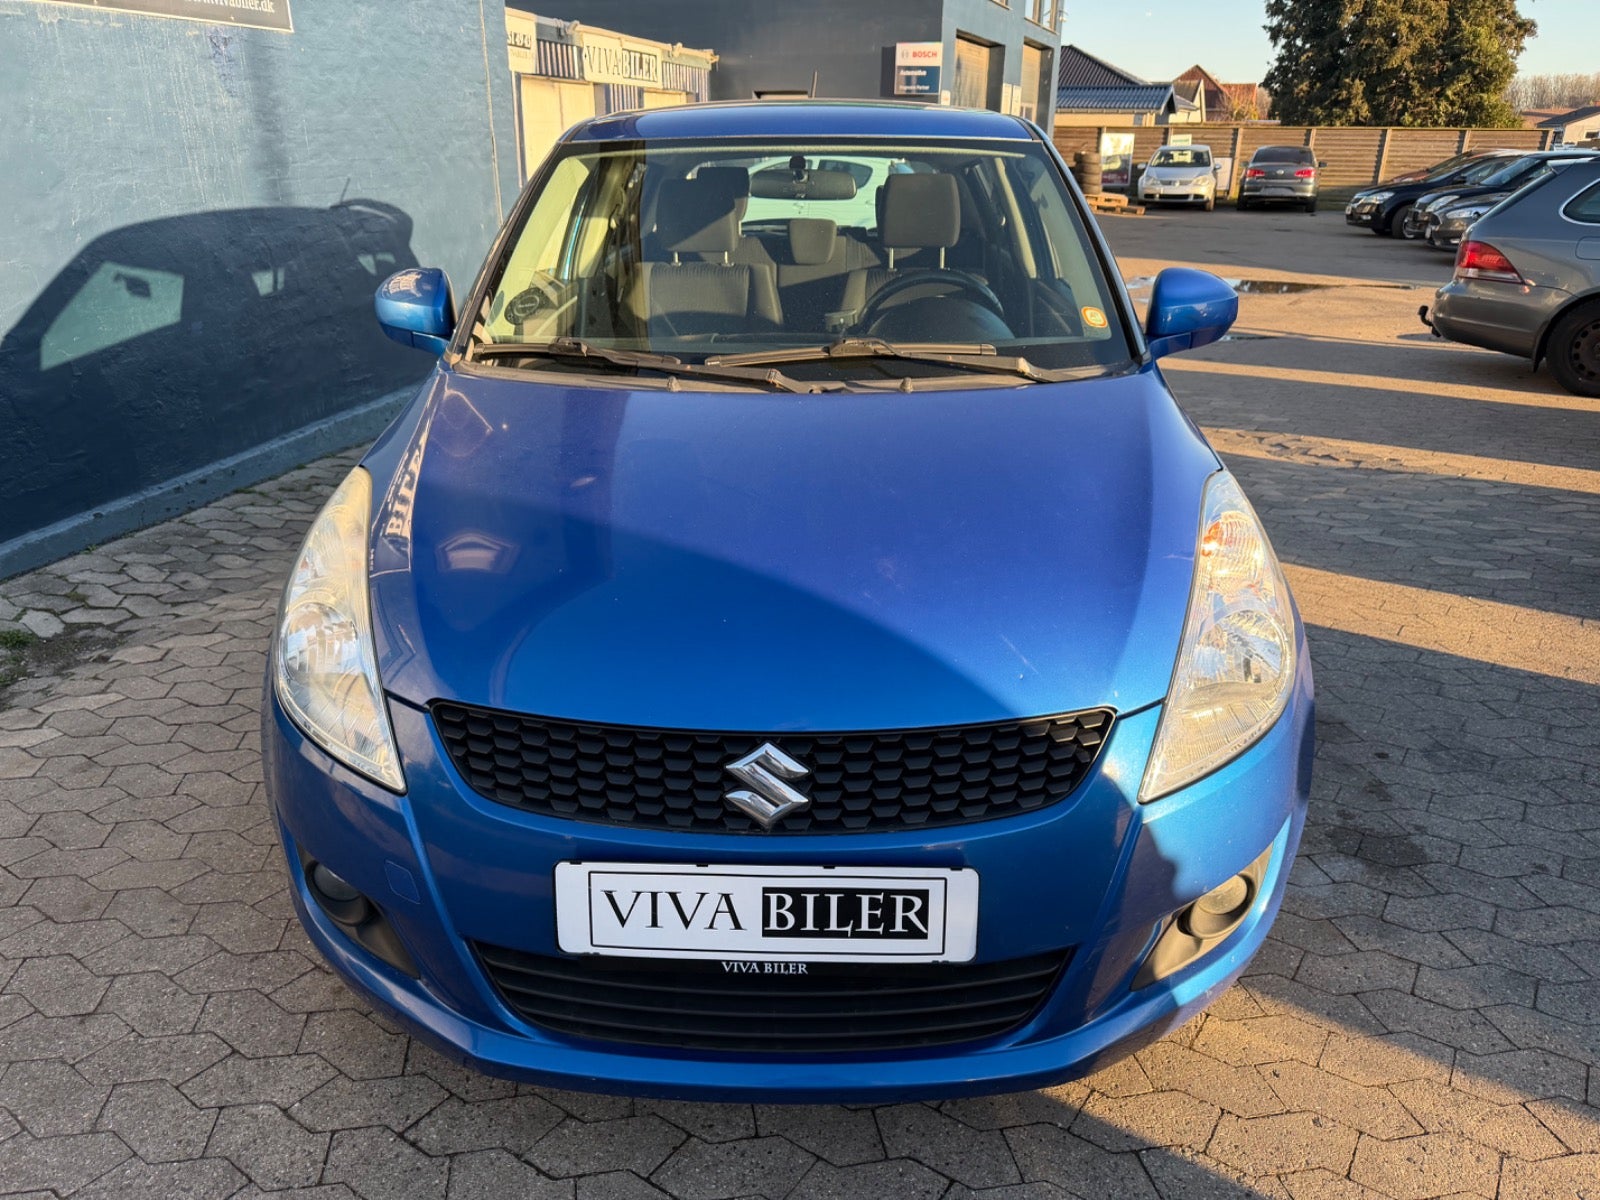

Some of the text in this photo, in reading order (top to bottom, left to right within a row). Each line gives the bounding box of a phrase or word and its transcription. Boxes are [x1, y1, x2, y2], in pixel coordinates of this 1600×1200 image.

[586, 45, 658, 82] VIVA BILER
[601, 890, 929, 937] VIVA BILER
[721, 961, 808, 975] VIVA BILER
